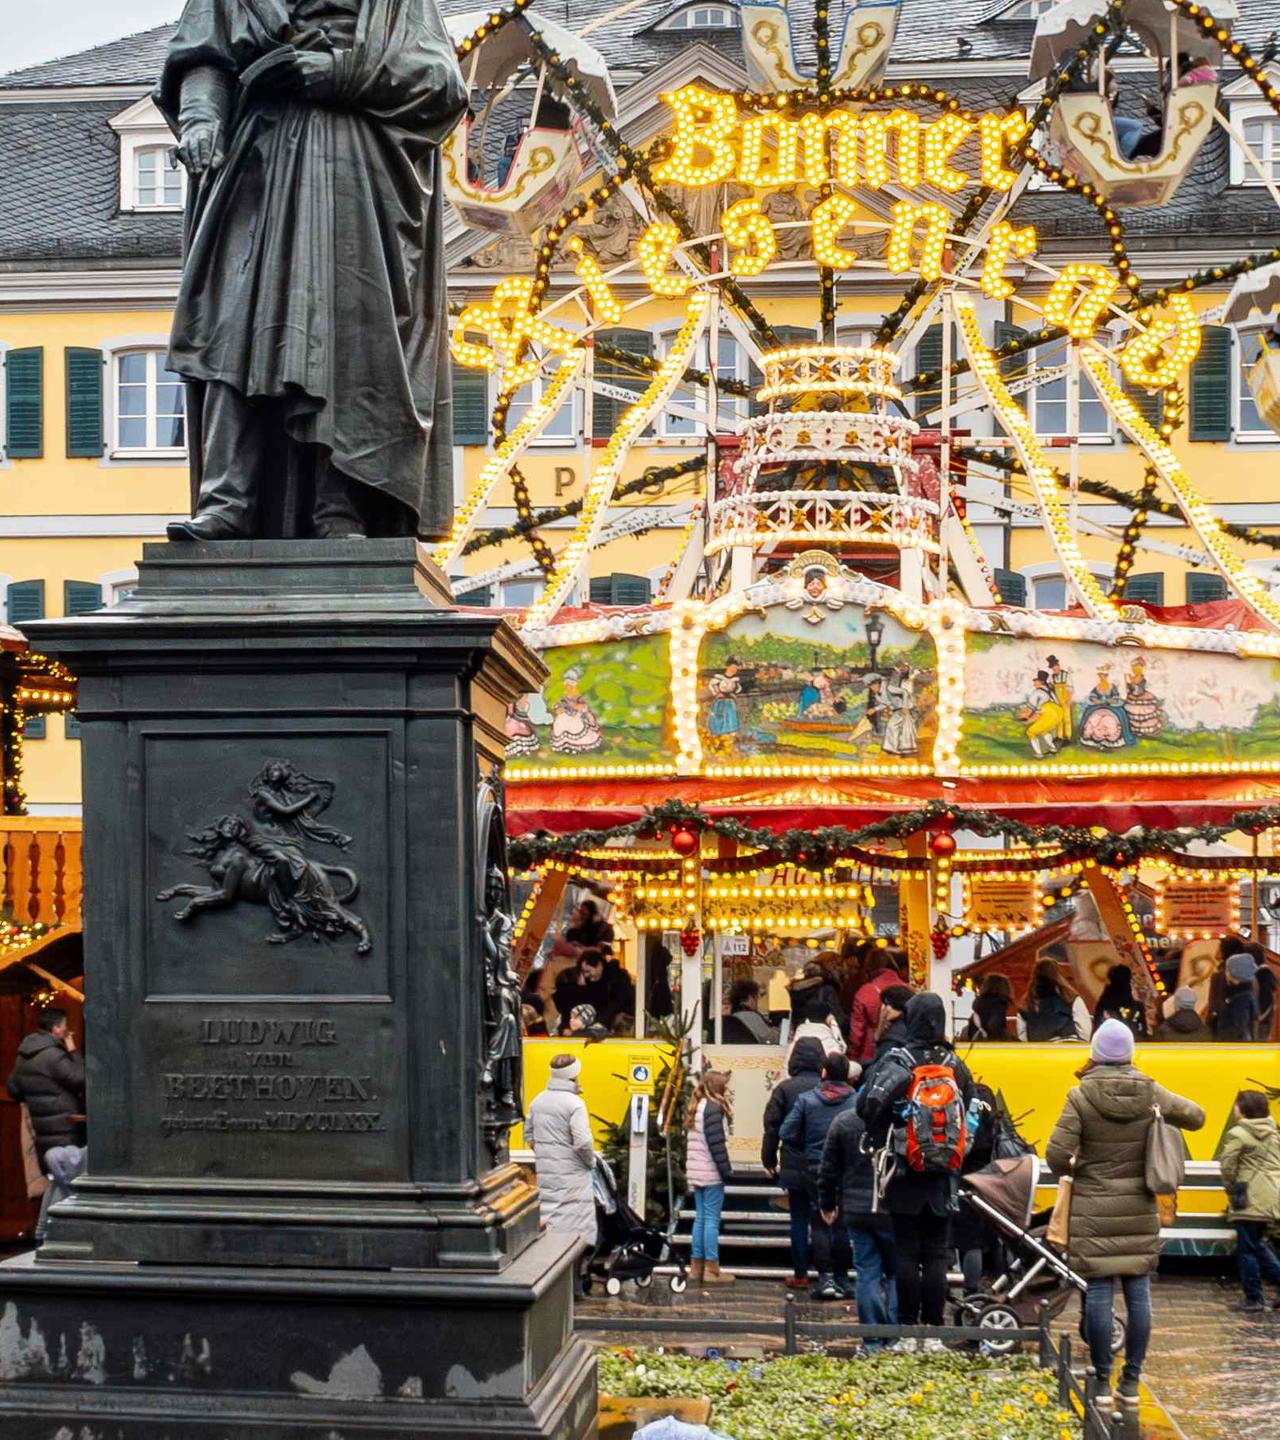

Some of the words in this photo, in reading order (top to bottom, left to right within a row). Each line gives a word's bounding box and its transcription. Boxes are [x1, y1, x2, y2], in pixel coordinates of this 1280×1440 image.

[655, 85, 1029, 192] Bonner
[451, 194, 1203, 392] Riesenrad
[554, 466, 701, 497] PS
[200, 1018, 338, 1045] LUDWIG
[162, 1072, 378, 1102] BEETHOVEN.
